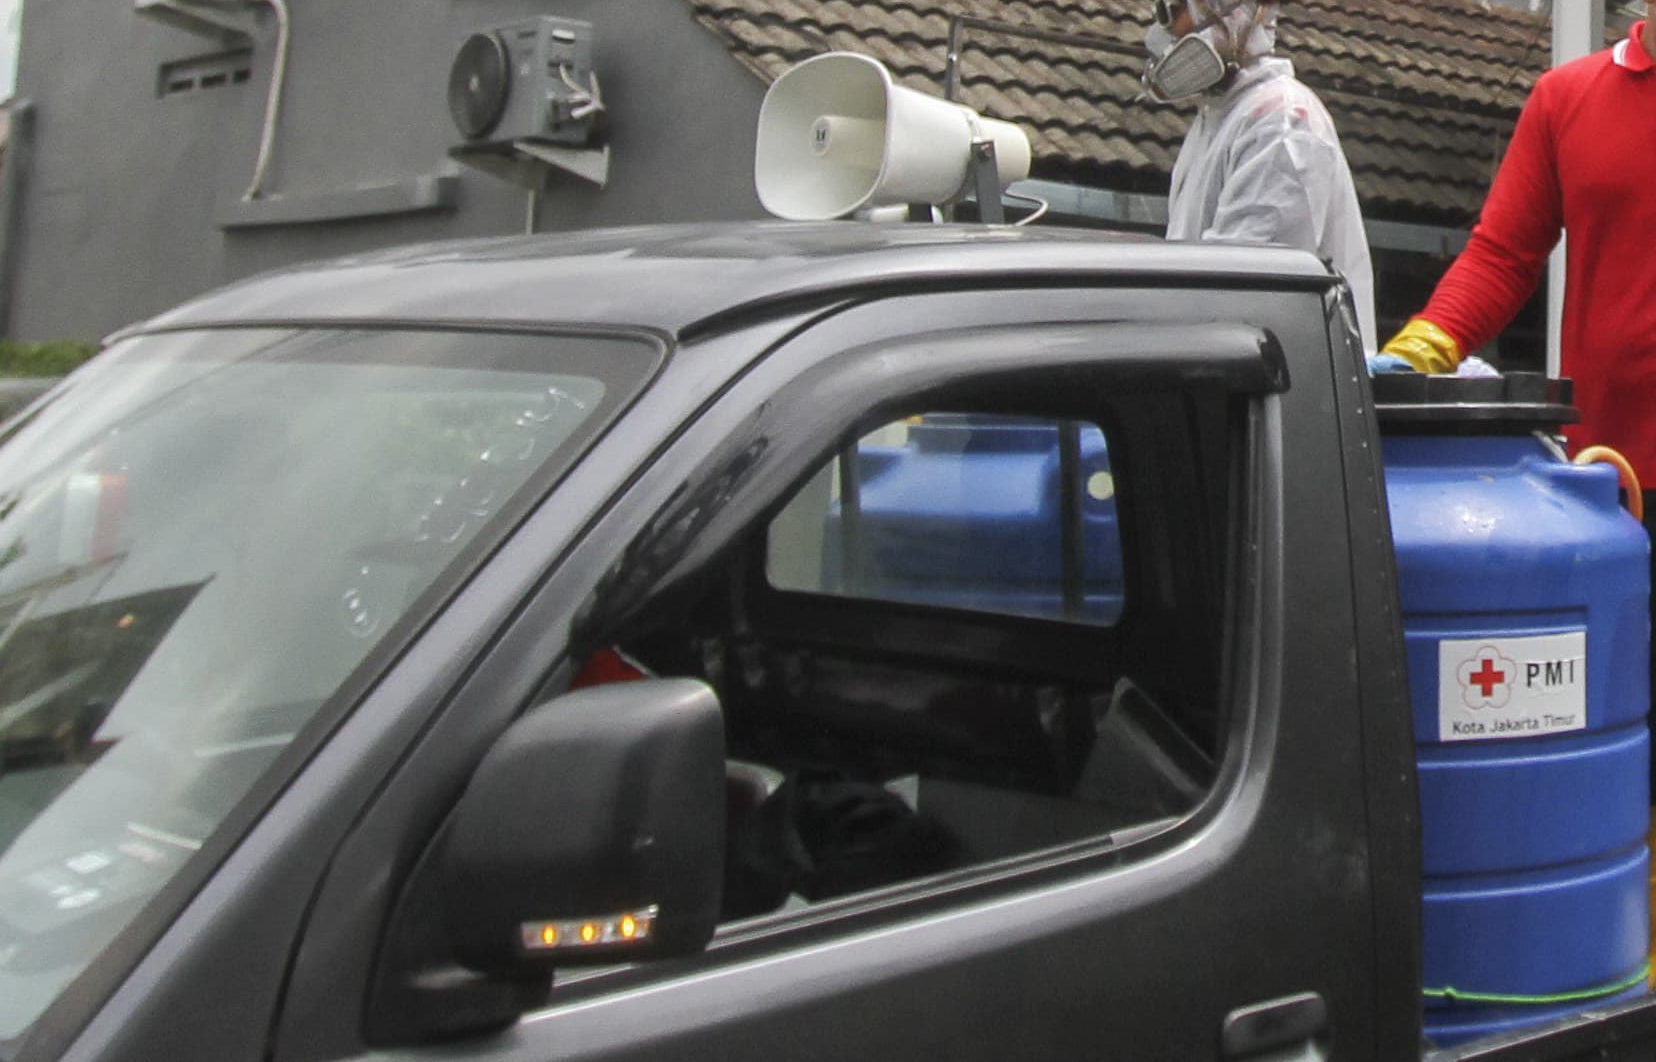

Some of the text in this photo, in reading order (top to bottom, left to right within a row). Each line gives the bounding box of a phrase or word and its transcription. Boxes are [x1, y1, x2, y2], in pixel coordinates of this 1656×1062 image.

[1526, 660, 1574, 688] PMI
[1452, 714, 1576, 735] Kota Jakarta Timur
